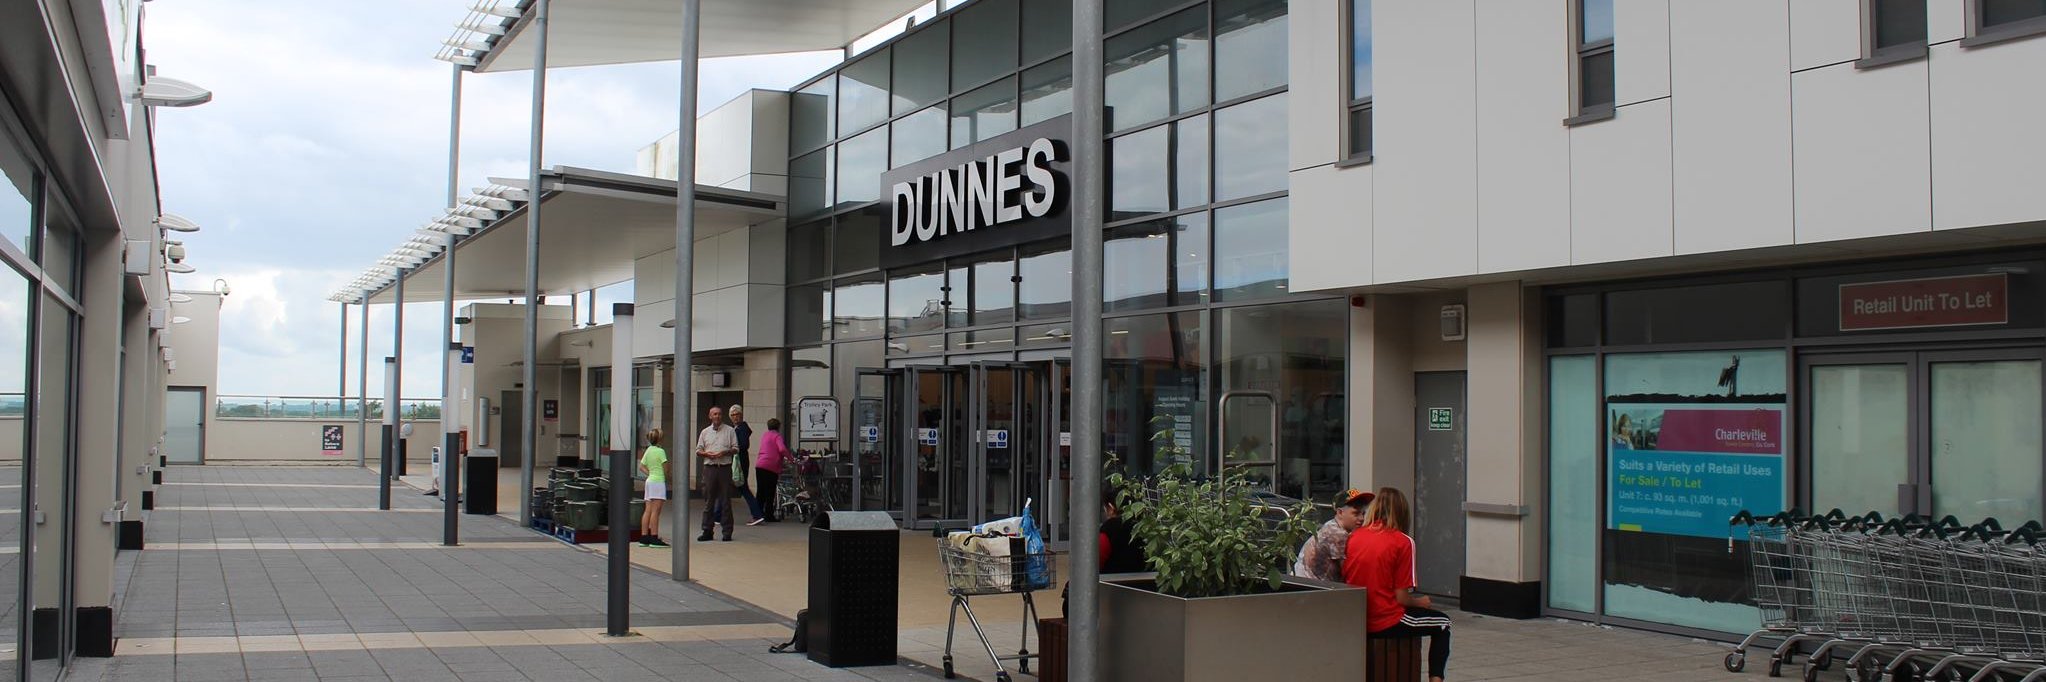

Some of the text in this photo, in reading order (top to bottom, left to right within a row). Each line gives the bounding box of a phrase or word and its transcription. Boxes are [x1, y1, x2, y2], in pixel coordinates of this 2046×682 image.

[892, 138, 1054, 246] DUNNES
[1854, 291, 1992, 314] Retail Unit To Let
[1715, 428, 1766, 441] Charleville
[1619, 459, 1644, 470] Suits
[1656, 461, 1691, 474] Variety
[1695, 462, 1705, 473] of
[1708, 463, 1740, 474] Retail
[1743, 464, 1772, 476] Uses
[1619, 474, 1702, 488] For Sale / To Let
[1618, 491, 1635, 500] Unit
[1653, 492, 1662, 501] 93
[1664, 495, 1676, 503] sq.
[1717, 498, 1728, 507] sq.
[1731, 497, 1743, 507] ft.)
[1618, 506, 1653, 515] Competitive
[1674, 509, 1702, 518] Available
